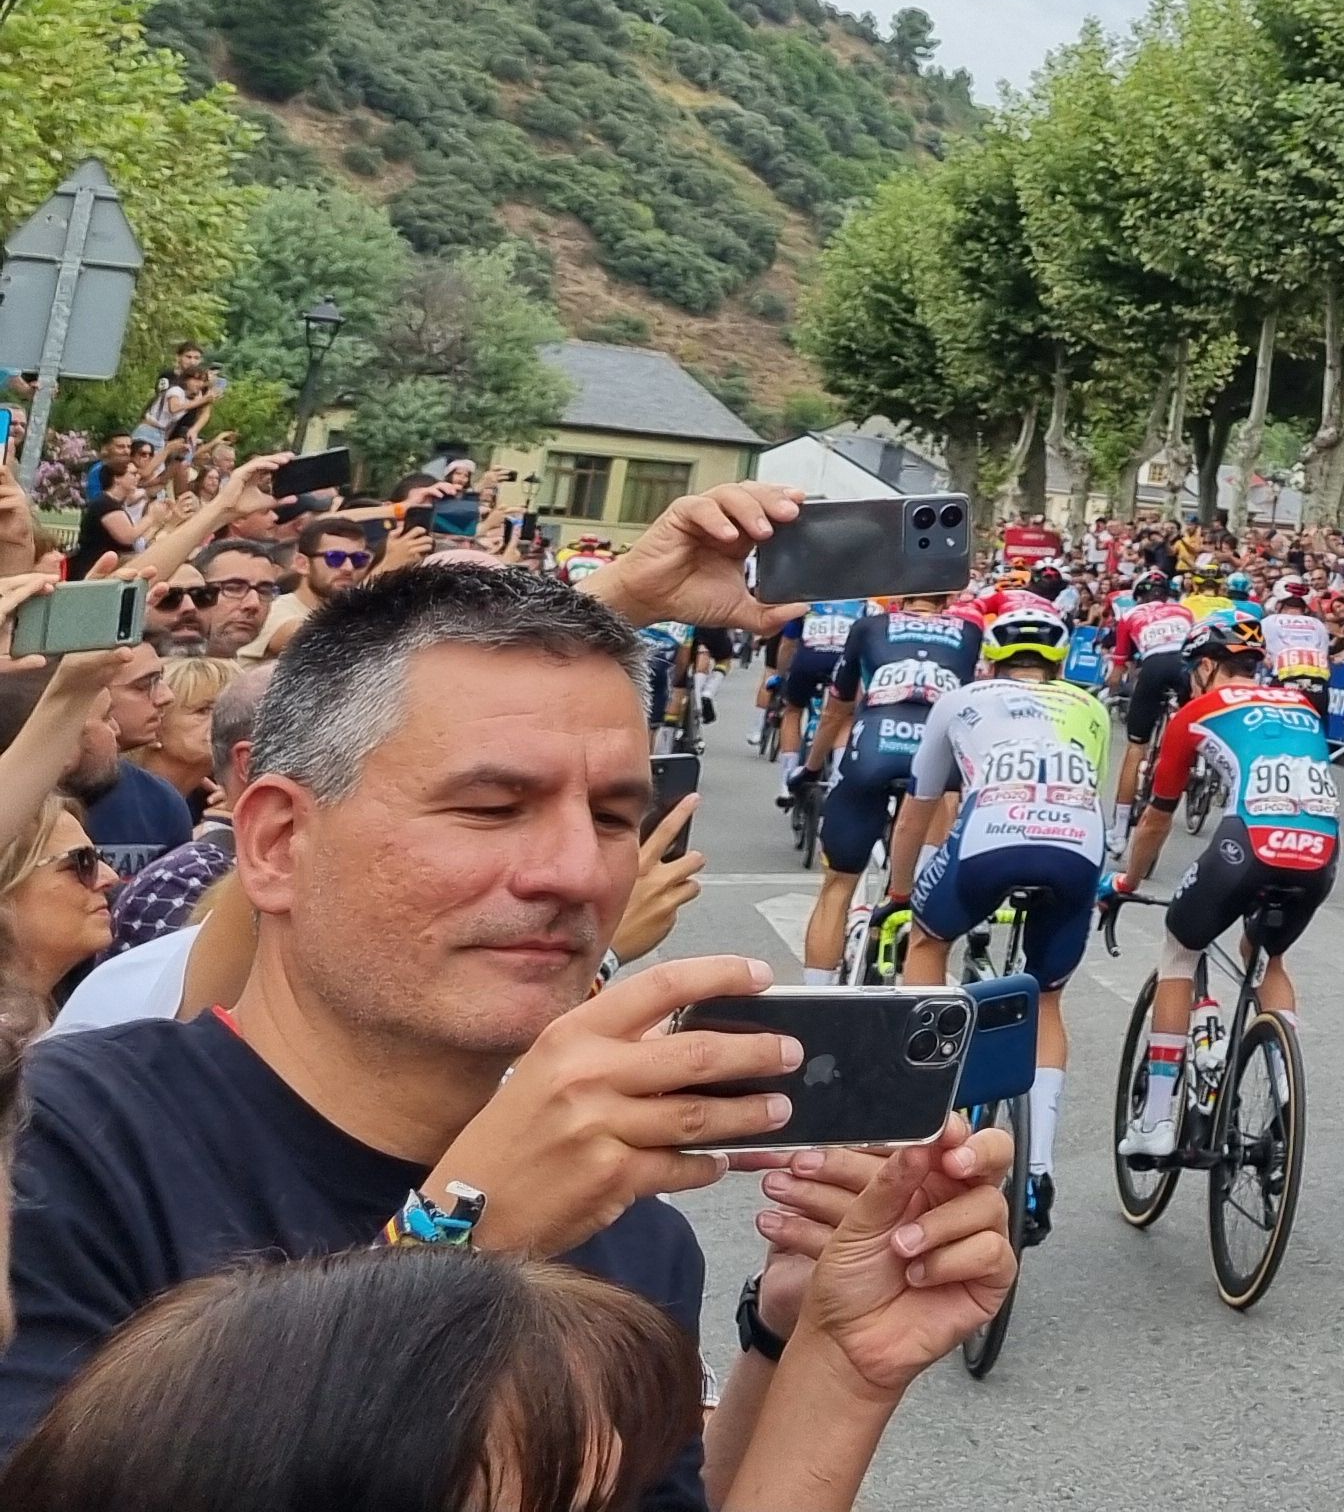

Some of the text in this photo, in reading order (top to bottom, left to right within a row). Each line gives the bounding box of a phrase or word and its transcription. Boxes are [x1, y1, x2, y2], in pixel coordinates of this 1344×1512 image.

[888, 620, 963, 641] BORA
[1281, 650, 1297, 666] 16
[879, 718, 926, 739] BOR
[1255, 762, 1292, 795] 96
[1008, 805, 1072, 824] Circus
[1268, 830, 1325, 855] CAPS
